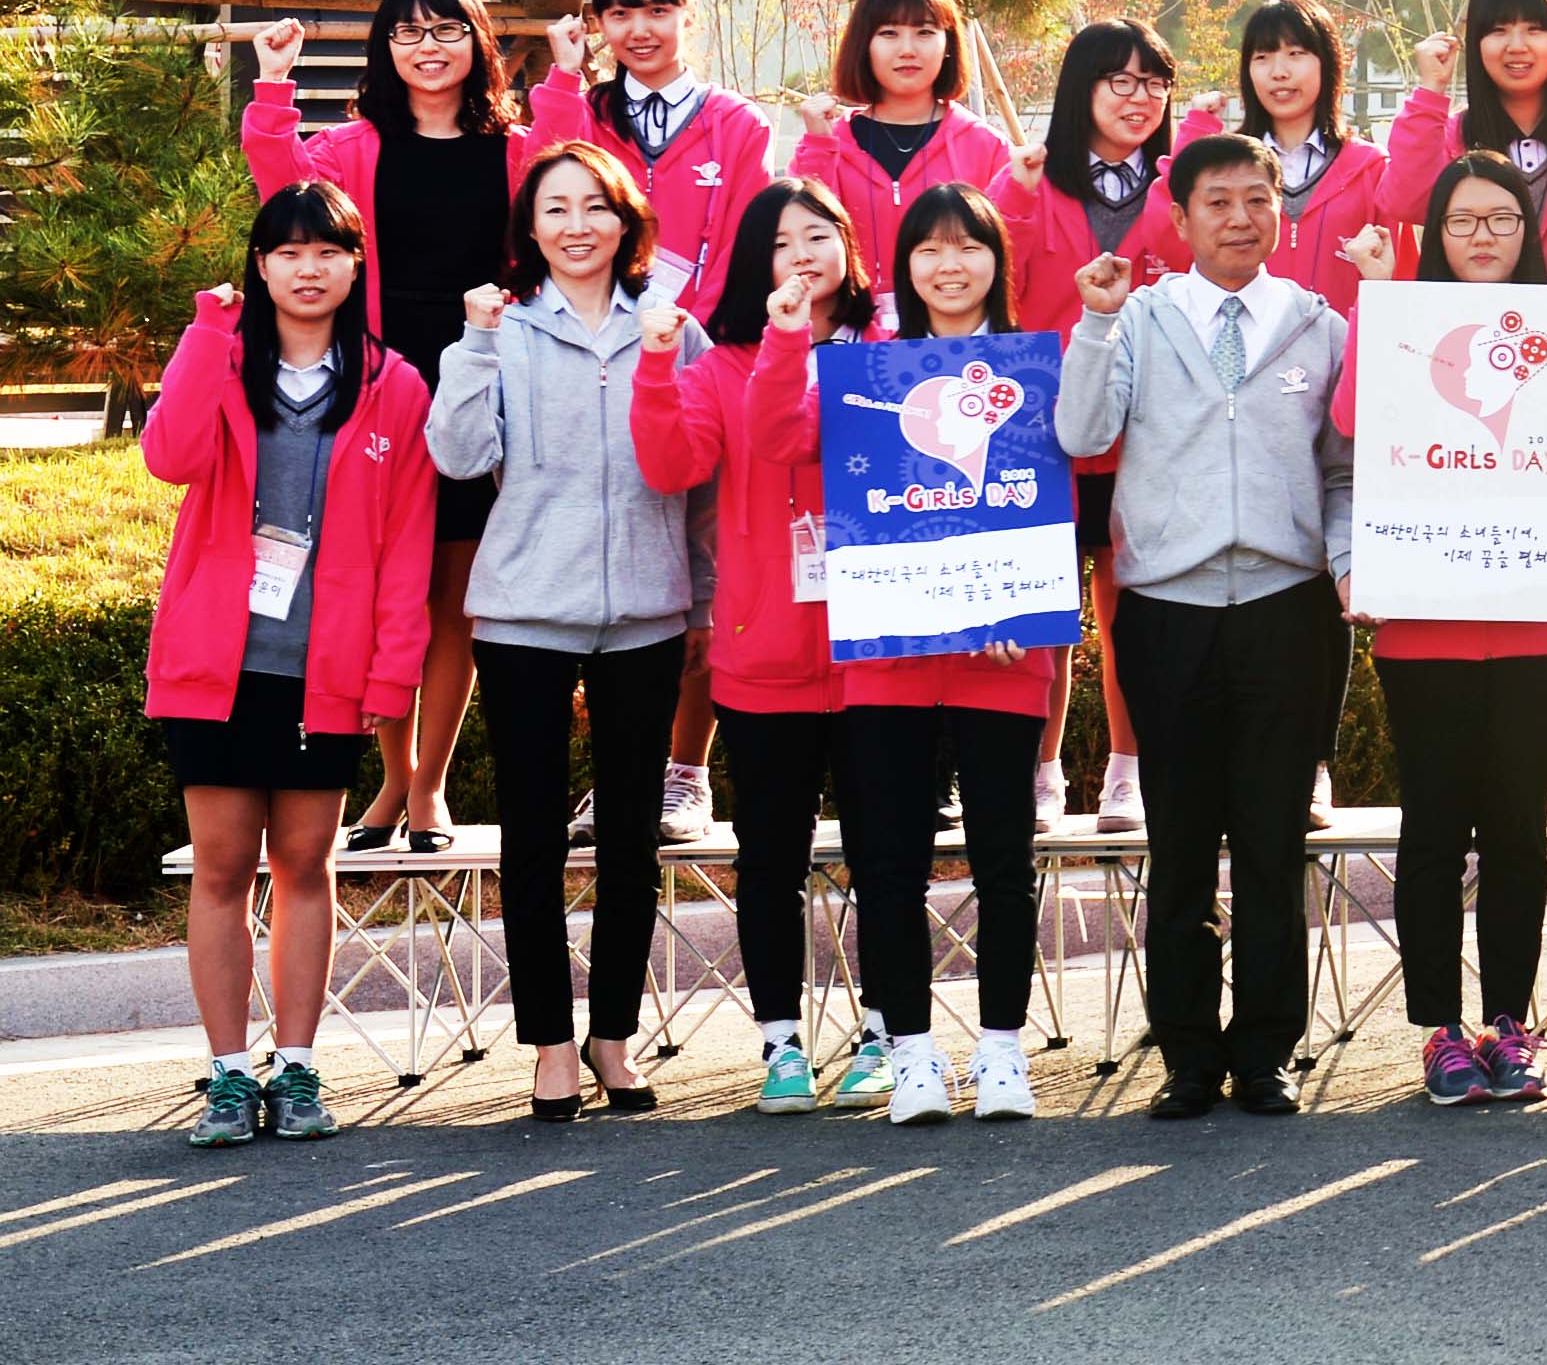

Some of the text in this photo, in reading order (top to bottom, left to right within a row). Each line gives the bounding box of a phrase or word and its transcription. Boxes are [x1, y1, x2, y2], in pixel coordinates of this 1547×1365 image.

[986, 481, 1038, 509] DAY
[1444, 549, 1472, 563] 이제
[1481, 549, 1508, 569] 꿈을
[925, 586, 954, 599] 이제
[963, 582, 993, 602] 꿈을
